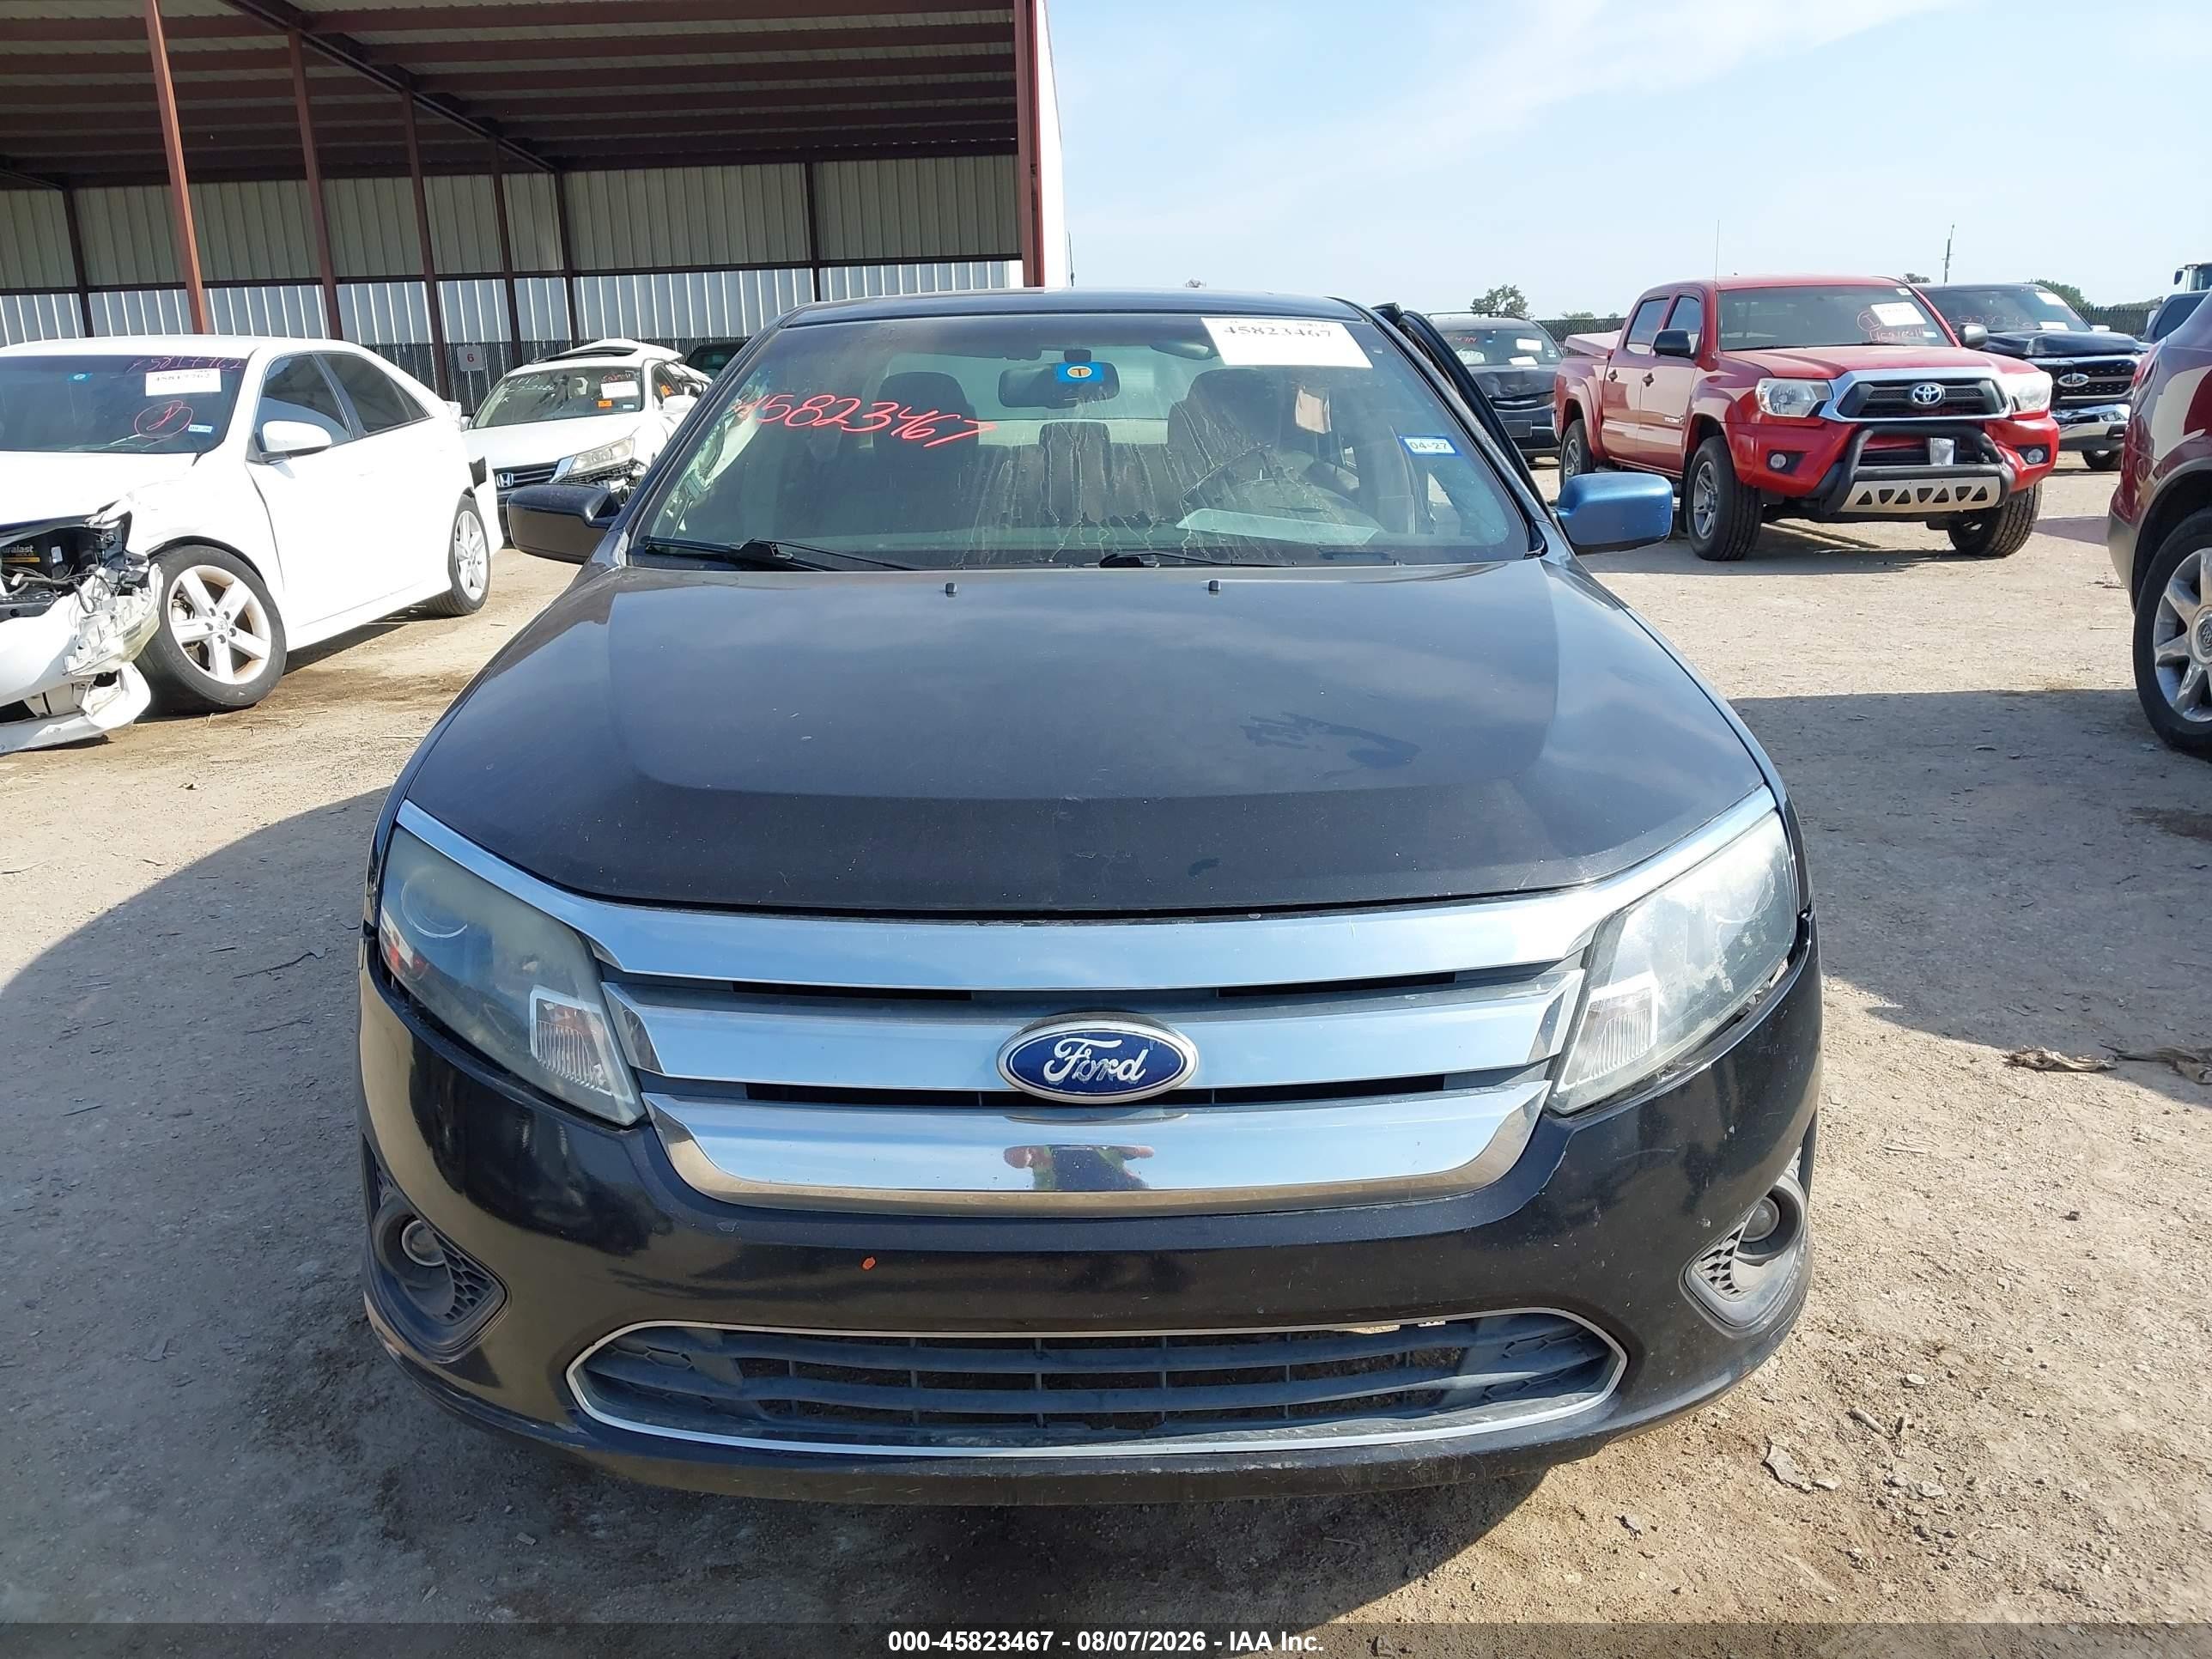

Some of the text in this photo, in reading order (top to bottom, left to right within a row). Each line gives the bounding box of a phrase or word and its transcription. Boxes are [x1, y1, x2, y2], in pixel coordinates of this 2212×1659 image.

[1224, 325, 1331, 337] 45823467
[467, 353, 475, 362] 6
[742, 394, 998, 447] 45823467
[1409, 441, 1447, 450] 04-27
[1043, 1037, 1148, 1082] Ford
